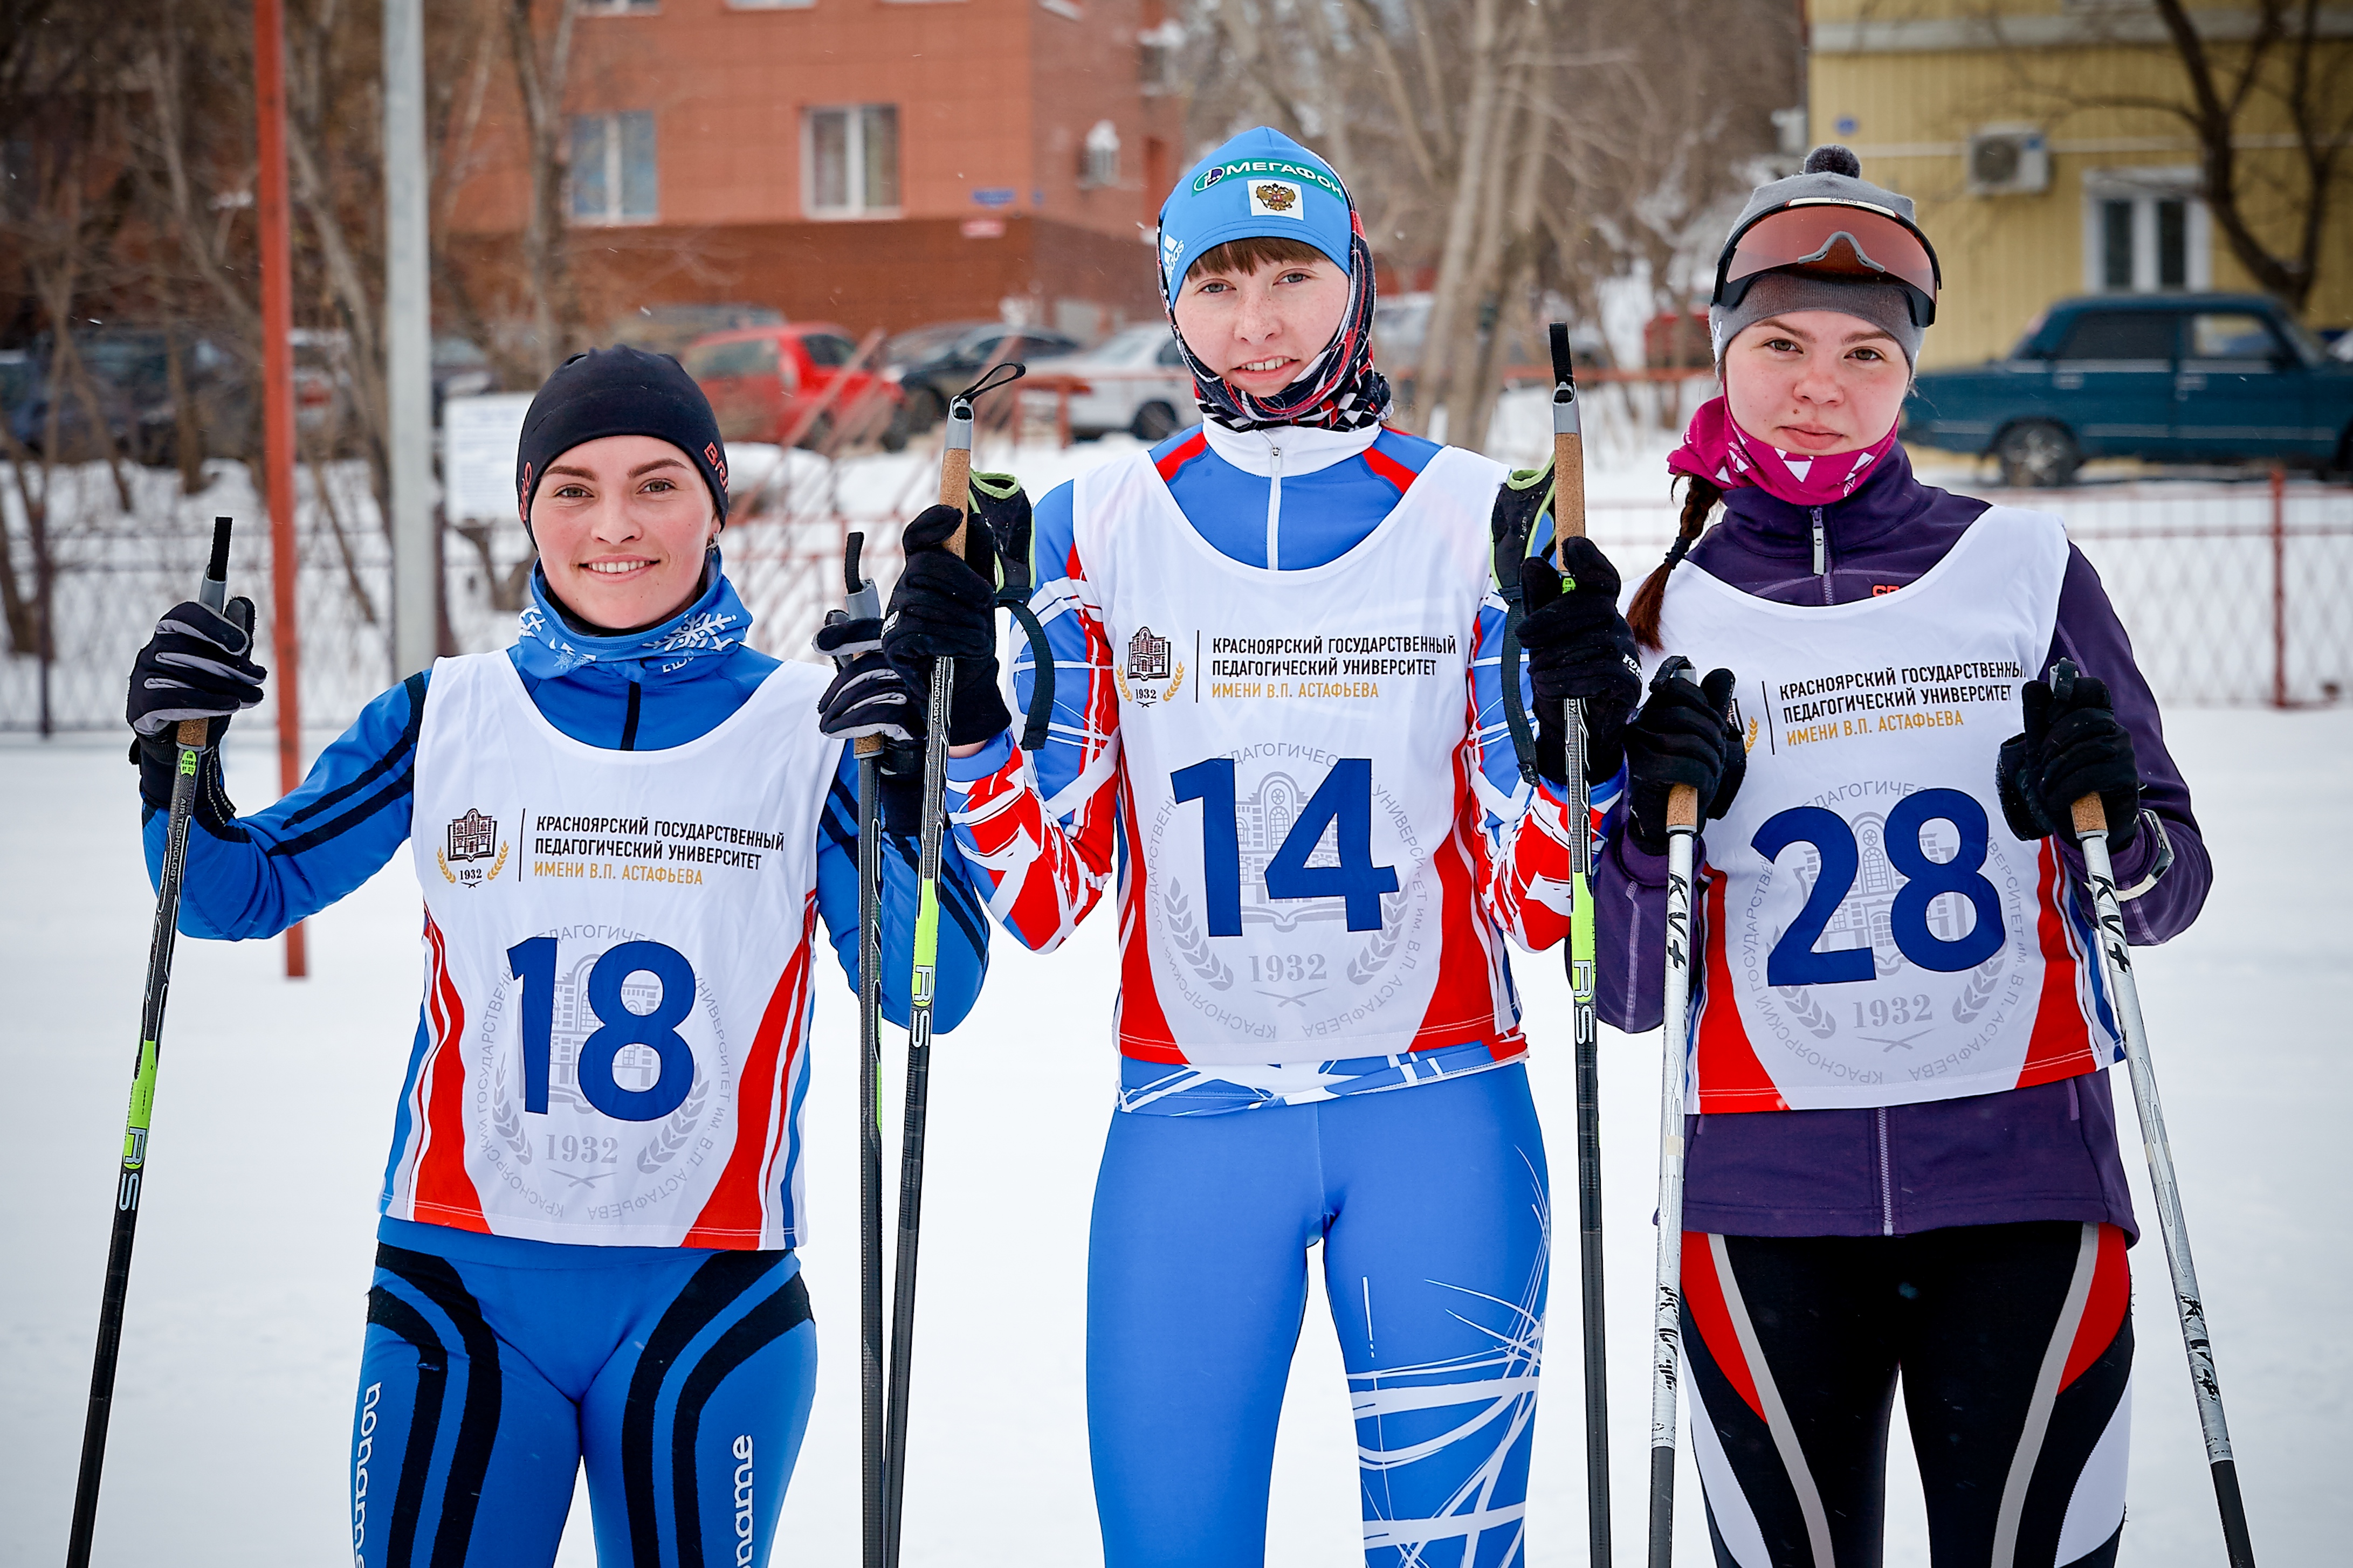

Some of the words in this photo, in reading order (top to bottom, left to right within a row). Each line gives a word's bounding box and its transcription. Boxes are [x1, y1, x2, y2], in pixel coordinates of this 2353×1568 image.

[1226, 161, 1343, 198] МЕГАФОН
[1213, 635, 1323, 655] КРАСНОЯРСКИЙ
[1328, 634, 1456, 655] ГОСУДАРСТВЕННЫЙ
[1212, 657, 1338, 678] ПЕДАГОГИЧЕСКИЙ
[1343, 658, 1437, 676] УНИВЕРСИТЕТ
[1779, 667, 1896, 701] КРАСНОЯРСКИЙ
[1901, 661, 2026, 684] ГОСУДАРСТВЕННЫ
[933, 657, 942, 723] TECHNOLOGY
[1135, 688, 1157, 700] 1932
[1212, 682, 1262, 698] ИМЕНИ
[1267, 683, 1293, 698] В.П.
[1298, 682, 1379, 698] АСТАФЬЕВА
[1783, 687, 1917, 724] ПЕДАГОГИЧЕСКИЙ
[1920, 685, 2012, 704] УНИВЕРСИТЕТ
[1786, 722, 1839, 747] ИМЕНИ
[1843, 717, 1873, 736] В.П.
[1878, 710, 1964, 733] АСТАФЬЕВА
[178, 797, 187, 815] AIR
[170, 817, 184, 883] TECHNOLOGY
[536, 816, 649, 837] КРАСНОЯРСКИЙ
[654, 820, 785, 852] ГОСУДАРСТВЕННЫЙ
[1170, 758, 1399, 936] 14
[534, 838, 663, 860] ПЕДАГОГИЧЕСКИЙ
[668, 844, 762, 871] УНИВЕРСИТЕТ
[459, 868, 483, 881] 1932
[534, 861, 584, 878] ИМЕНИ
[590, 863, 617, 880] В.П.
[622, 865, 704, 885] АСТАФЬЕВА
[1751, 788, 2006, 986] 28
[1248, 953, 1328, 983] 1932
[1400, 941, 1421, 971] В.П.
[1301, 974, 1403, 1038] АСТАФЬЕВА
[2001, 973, 2024, 1006] В.П.
[1853, 993, 1933, 1028] 1932
[506, 936, 697, 1122] 18
[1755, 994, 1883, 1085] КРАСНОЯРСКИЙ
[1908, 1012, 2005, 1081] АСТАФЬЕВА
[546, 1134, 619, 1164] 1932
[687, 1137, 714, 1168] В.П.
[477, 1118, 565, 1218] КРАСНОЯРСКИЙ
[588, 1168, 687, 1220] АСТАФЬЕВА
